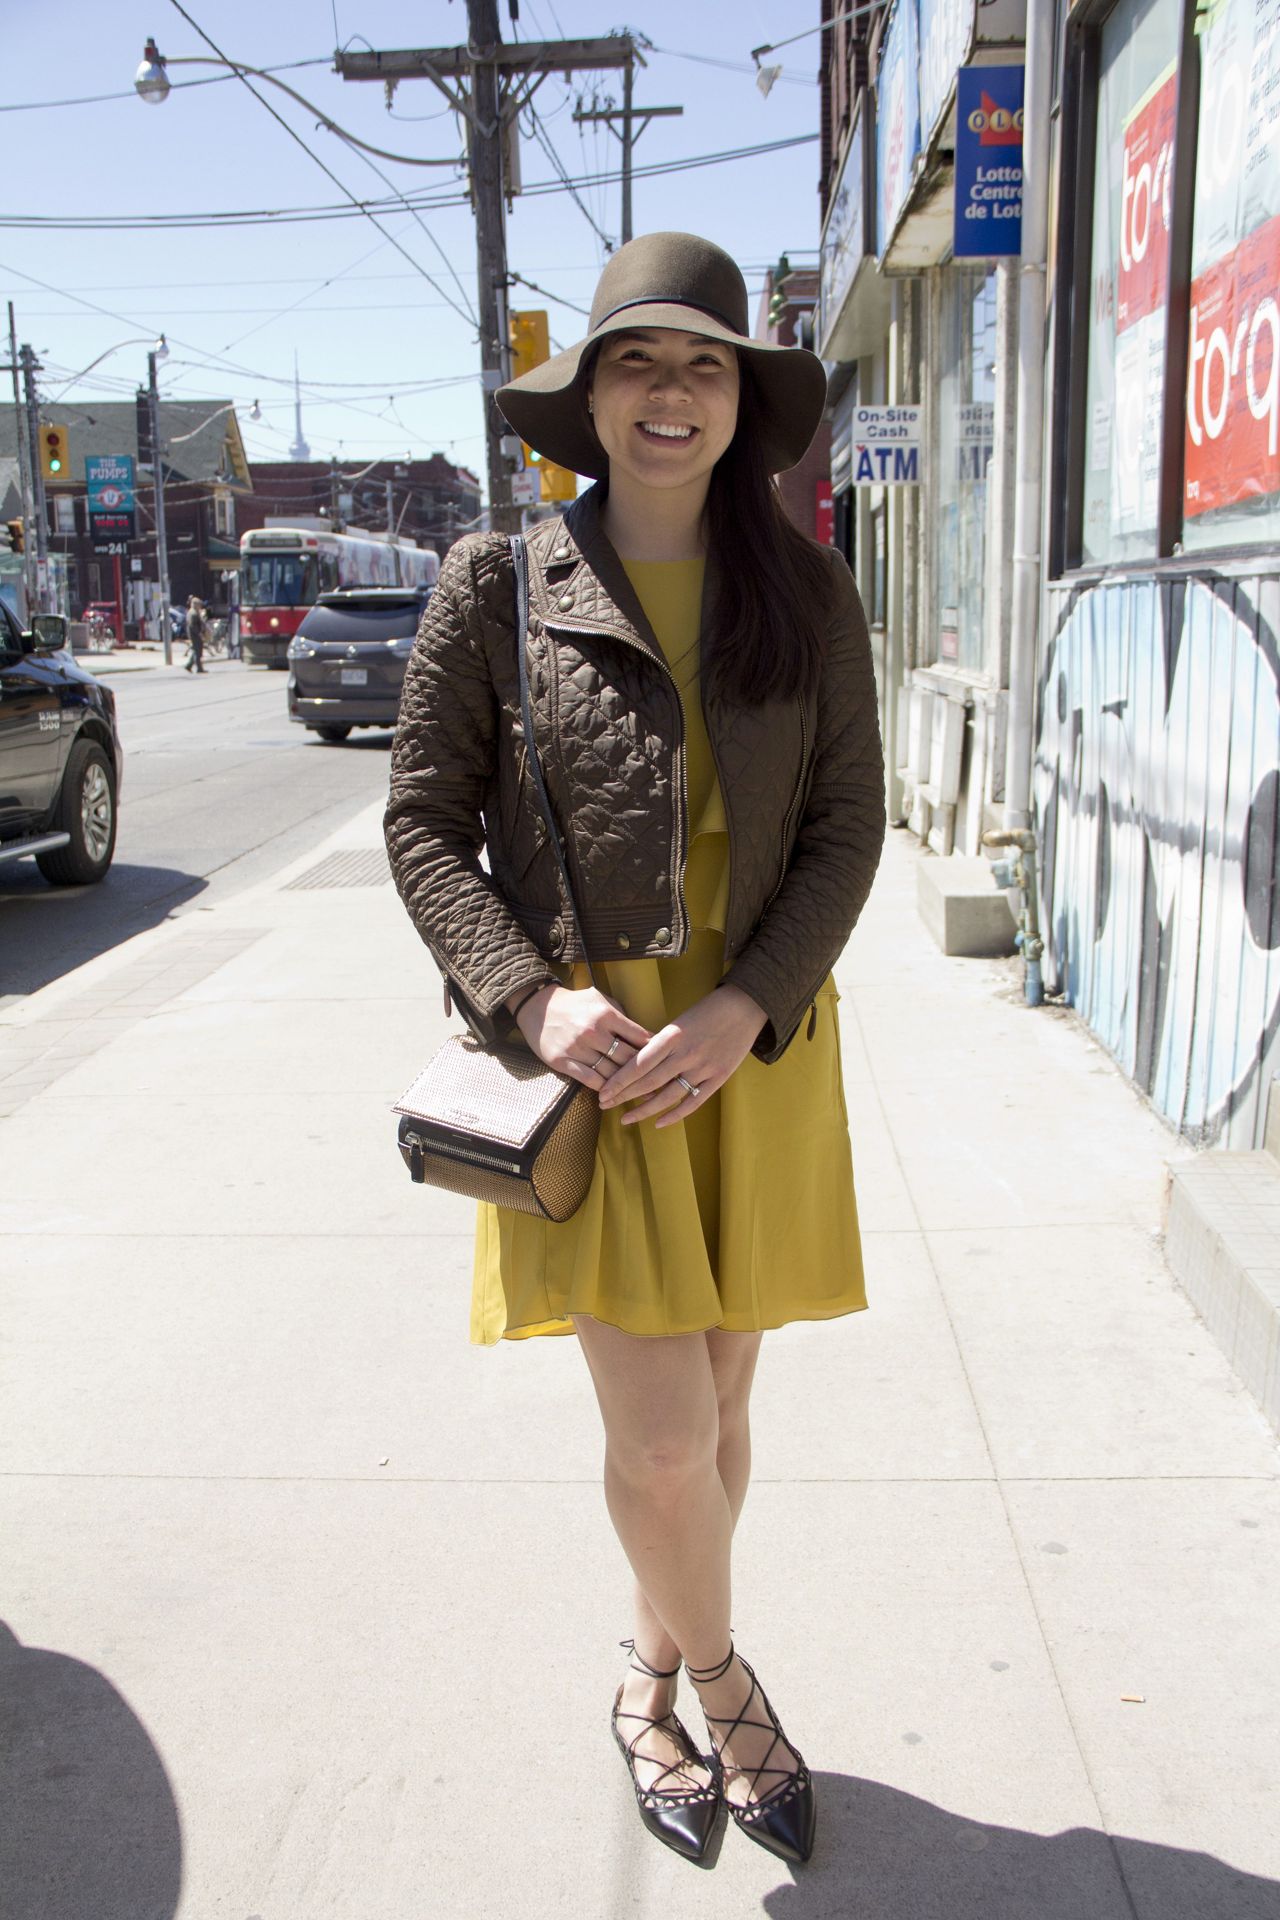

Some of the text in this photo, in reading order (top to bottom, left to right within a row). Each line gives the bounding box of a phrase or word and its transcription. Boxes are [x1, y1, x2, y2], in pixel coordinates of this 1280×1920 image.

[976, 166, 1023, 183] Lotto
[965, 203, 988, 219] de
[857, 409, 918, 422] On-Site
[866, 425, 908, 437] Cash
[856, 447, 918, 481] ATM
[90, 468, 128, 480] PUMPS
